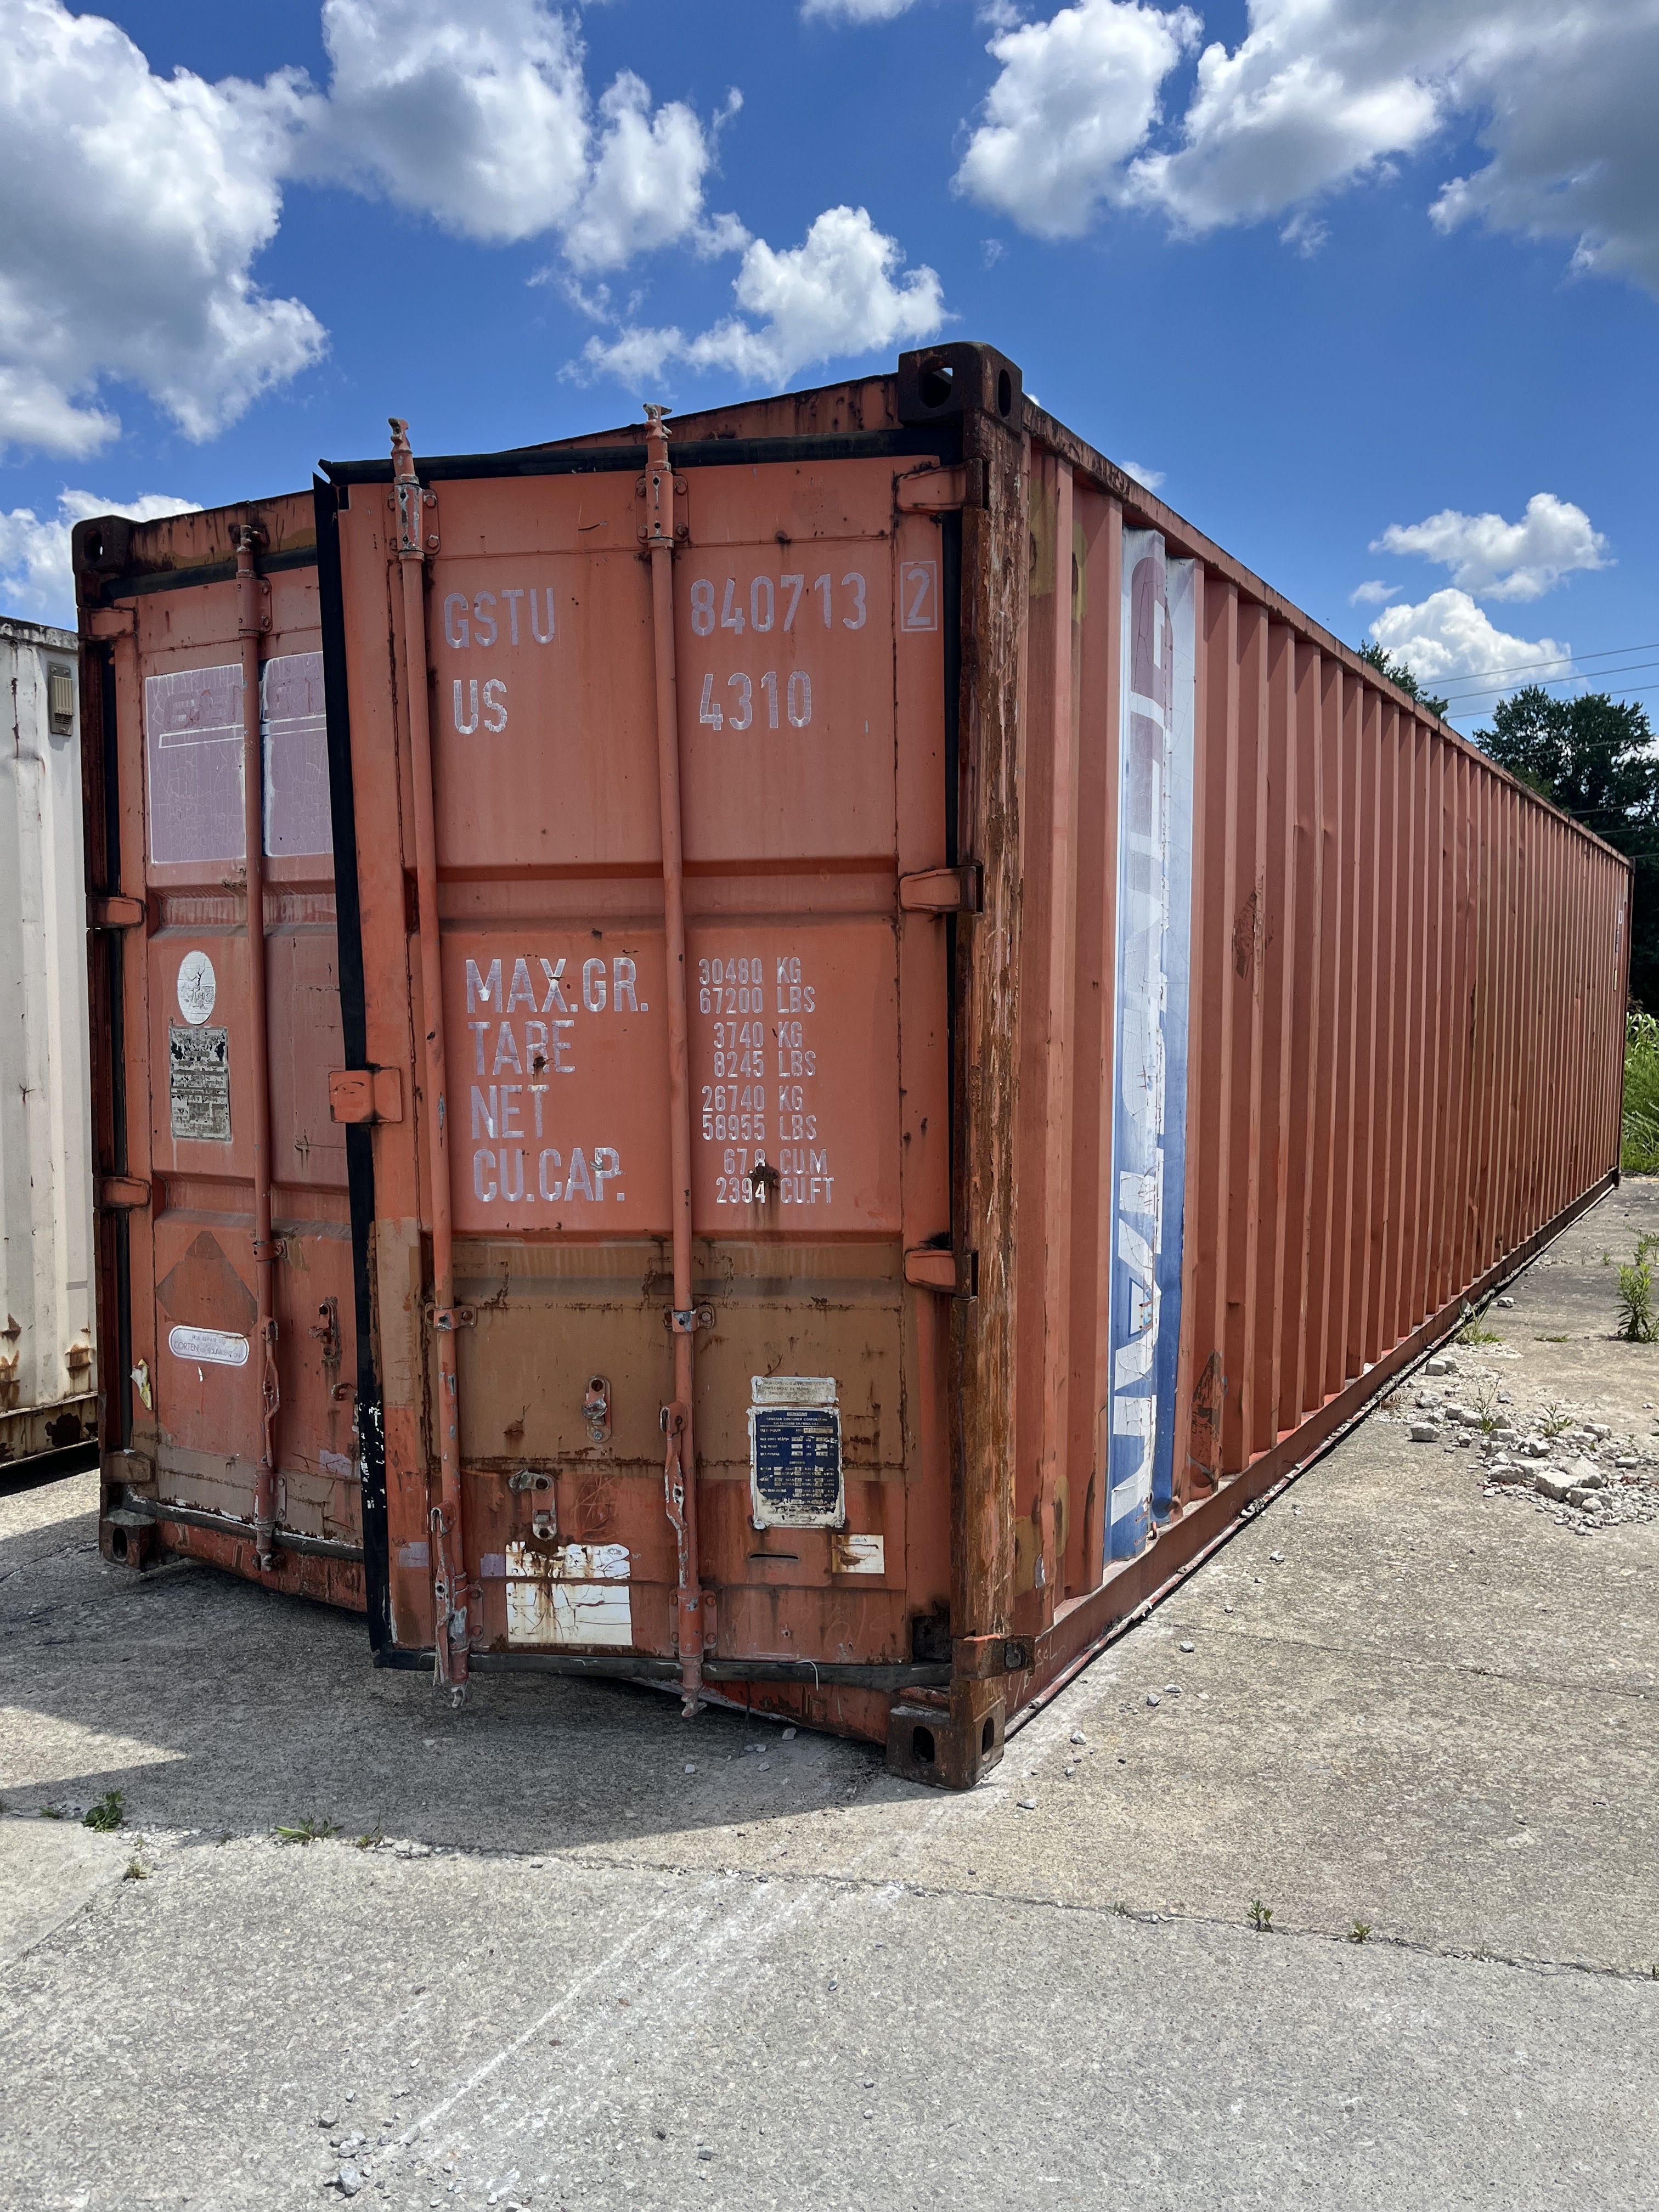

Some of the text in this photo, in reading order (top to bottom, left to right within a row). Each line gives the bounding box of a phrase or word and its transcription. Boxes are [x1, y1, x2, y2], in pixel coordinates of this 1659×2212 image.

[444, 567, 932, 648] GSTU 840713 2
[453, 670, 812, 735] US 4310
[466, 957, 802, 1014] MAX.GR. 30480 KG
[699, 986, 816, 1014] 67200 LBS
[467, 1019, 803, 1075] TARE 3740 KG
[714, 1051, 816, 1077] 8245 LBS
[470, 1084, 803, 1139] NET 26740 KG
[702, 1114, 817, 1141] 58955 LBS
[473, 1147, 625, 1202] CU.CAP.
[780, 1148, 827, 1175] CU.M
[716, 1177, 834, 1203] 2394 CU.FT
[174, 1341, 199, 1352] CORTEN
